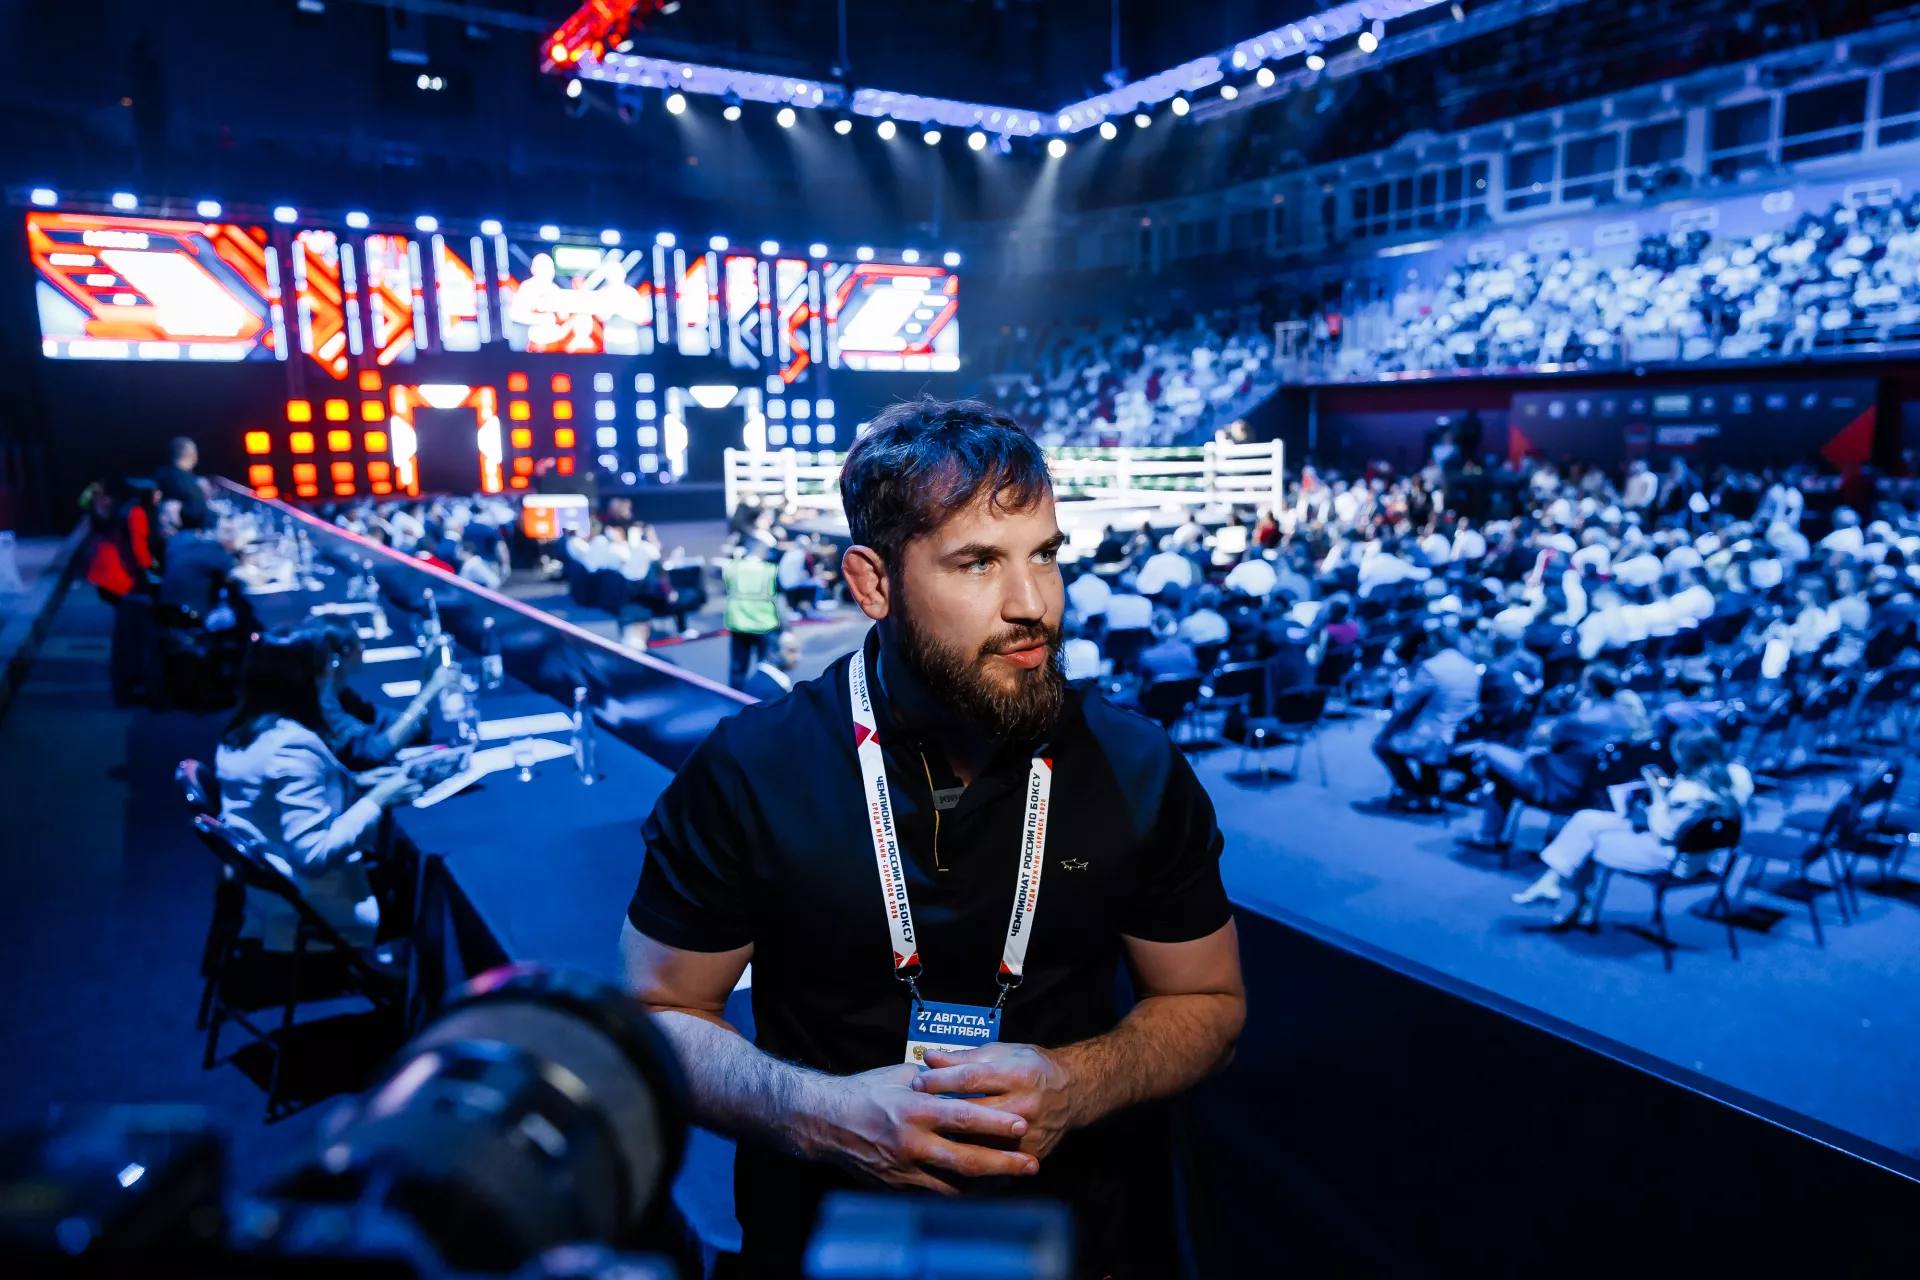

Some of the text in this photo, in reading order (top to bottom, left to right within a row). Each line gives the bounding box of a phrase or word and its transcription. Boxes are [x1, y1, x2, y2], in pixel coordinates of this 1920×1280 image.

[859, 679, 870, 712] БОКСУ
[872, 802, 881, 825] СРЕДИ
[876, 828, 887, 858] МУЖЧИН
[876, 776, 914, 943] ЧЕМПИОНАТ РОССИИ ПО БОКСУ
[1011, 773, 1041, 936] ЧЕМПИОНАТ РОССИИ ПО БОКСУ
[883, 864, 895, 897] САРАНСК
[1026, 888, 1036, 912] СРЕДИ
[1031, 855, 1041, 885] МУЖЧИН
[1036, 818, 1044, 849] САРАНСК
[917, 1011, 931, 1021] 27
[933, 1013, 985, 1026] АВГУСТА
[919, 1023, 990, 1038] 4 СЕНТЯБРЯ
